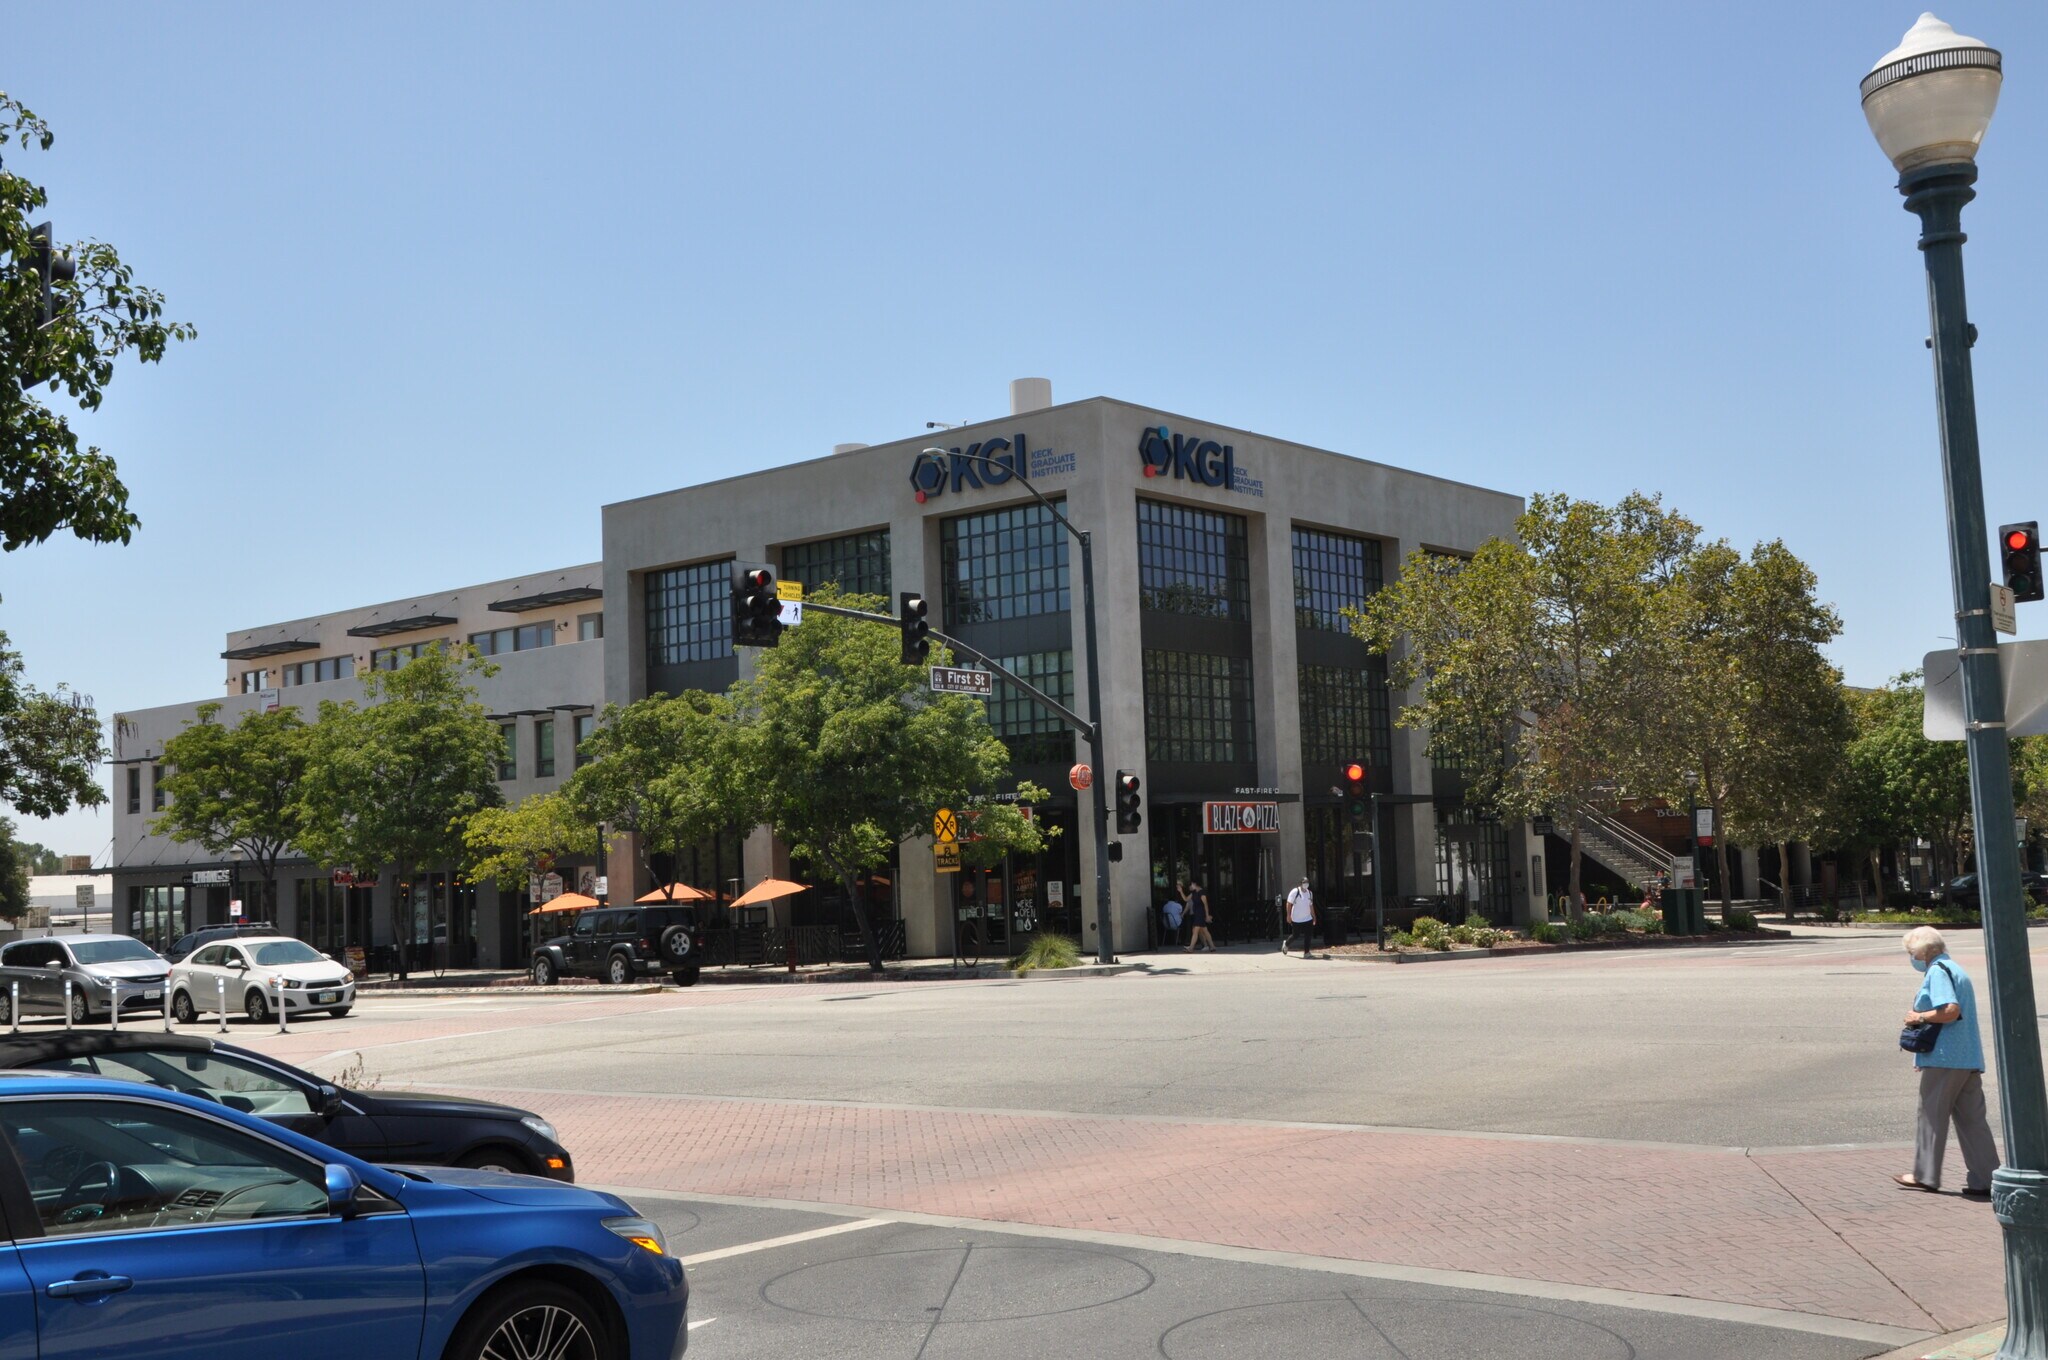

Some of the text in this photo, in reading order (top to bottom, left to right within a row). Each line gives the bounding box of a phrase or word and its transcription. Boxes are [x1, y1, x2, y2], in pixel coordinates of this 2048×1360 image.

[1031, 447, 1053, 460] KECK
[1031, 453, 1076, 469] GRADUATE
[1173, 432, 1234, 490] KGI
[950, 433, 1027, 493] KGI
[1031, 462, 1076, 479] INSTITUTE
[947, 671, 985, 686] First St
[1212, 804, 1281, 832] BLAZE PIZZA
[944, 848, 950, 857] 2
[937, 857, 959, 866] TRACKS
[1019, 908, 1036, 918] OPEN
